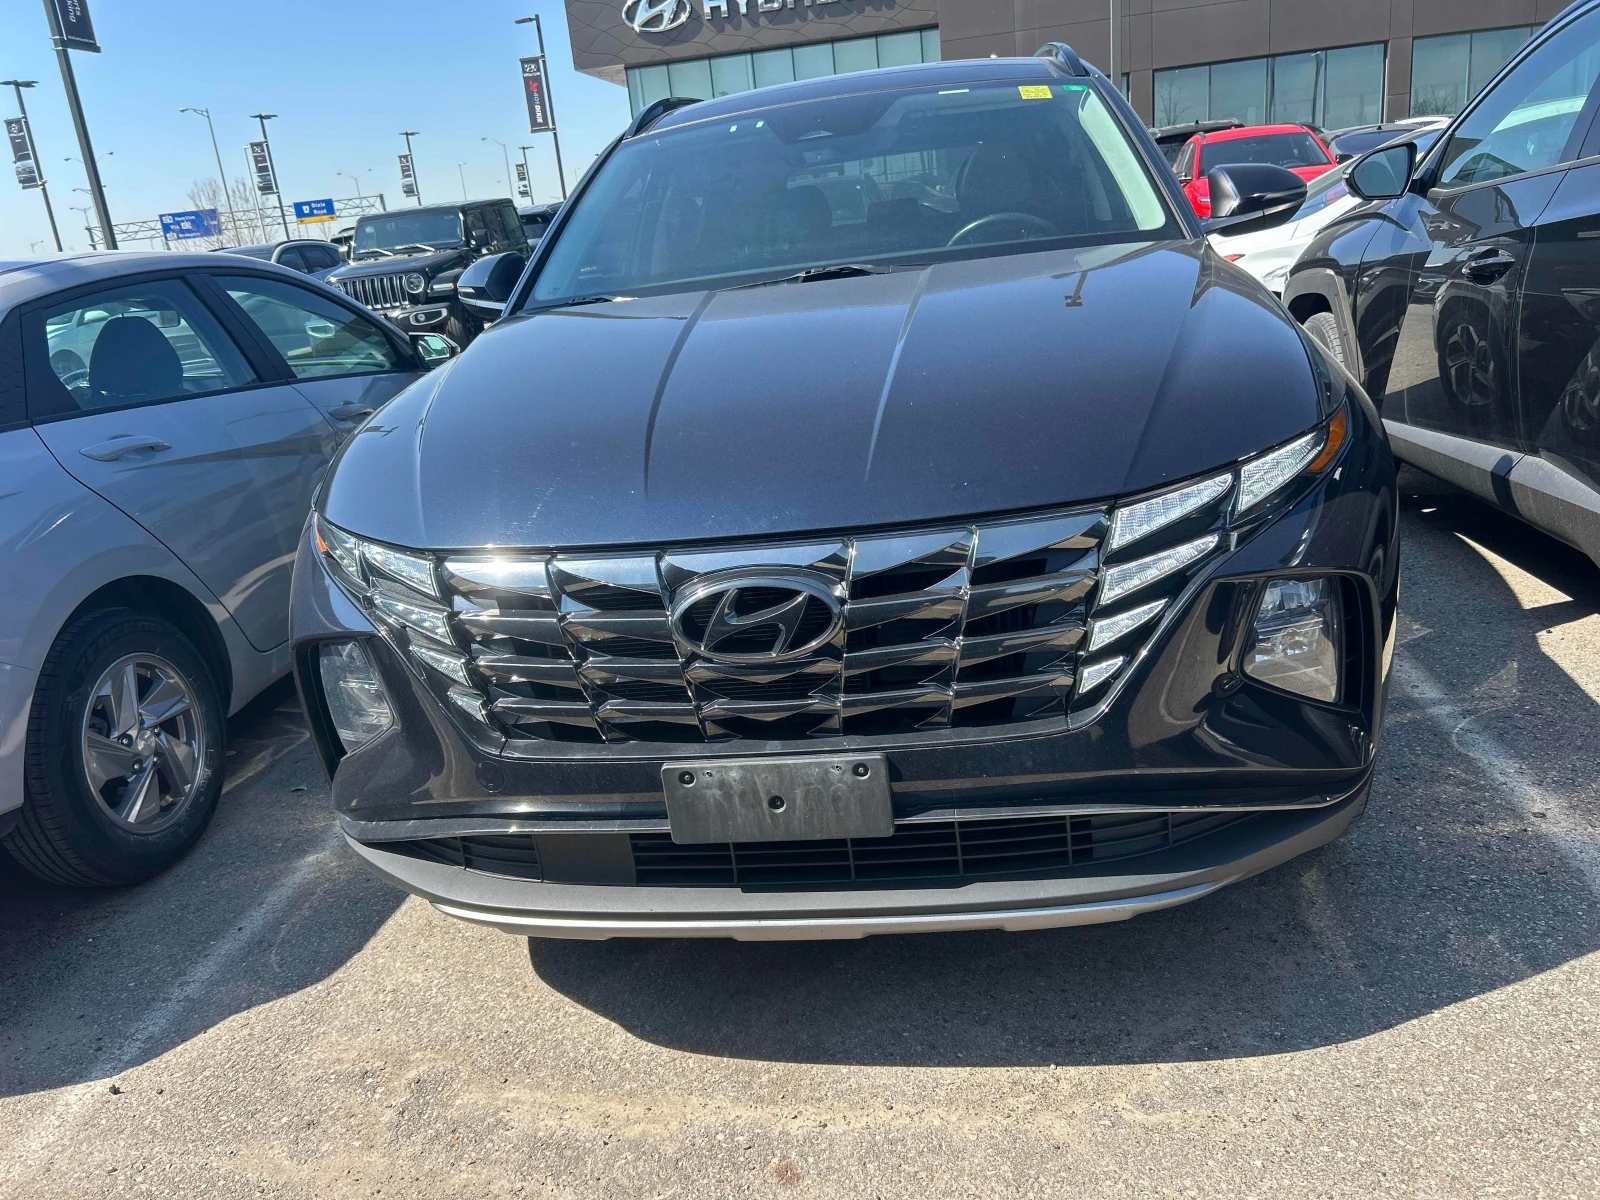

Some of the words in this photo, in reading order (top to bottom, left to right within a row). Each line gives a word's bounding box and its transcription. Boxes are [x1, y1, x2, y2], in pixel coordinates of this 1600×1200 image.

[67, 0, 76, 22] king
[73, 0, 81, 16] rts
[535, 104, 543, 123] DIXIE
